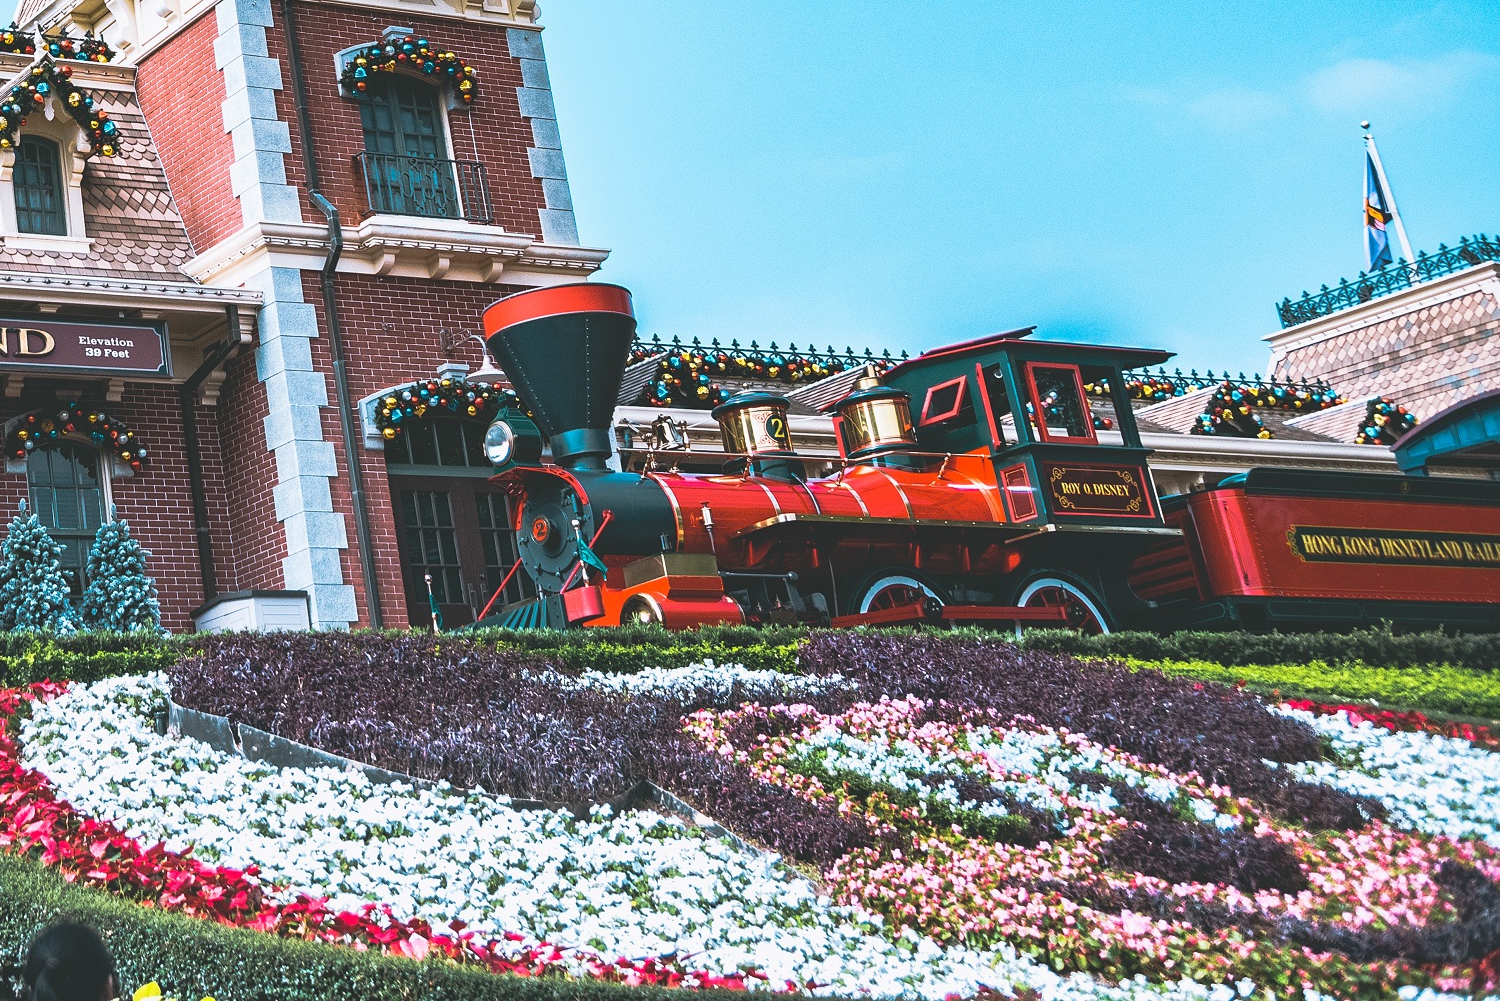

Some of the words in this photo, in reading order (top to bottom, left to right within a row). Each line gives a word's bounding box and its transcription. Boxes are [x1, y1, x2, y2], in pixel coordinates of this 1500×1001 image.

[78, 336, 134, 347] Elevation
[85, 347, 102, 357] 39
[103, 348, 130, 359] Feet
[771, 418, 785, 438] 2
[1061, 482, 1080, 494] ROY
[1083, 483, 1093, 495] O.
[1093, 483, 1129, 496] DISNEY
[535, 522, 546, 537] 2
[1301, 534, 1342, 555] HONG
[1341, 535, 1380, 556] KONG
[1379, 537, 1462, 559] DISNEYLAND
